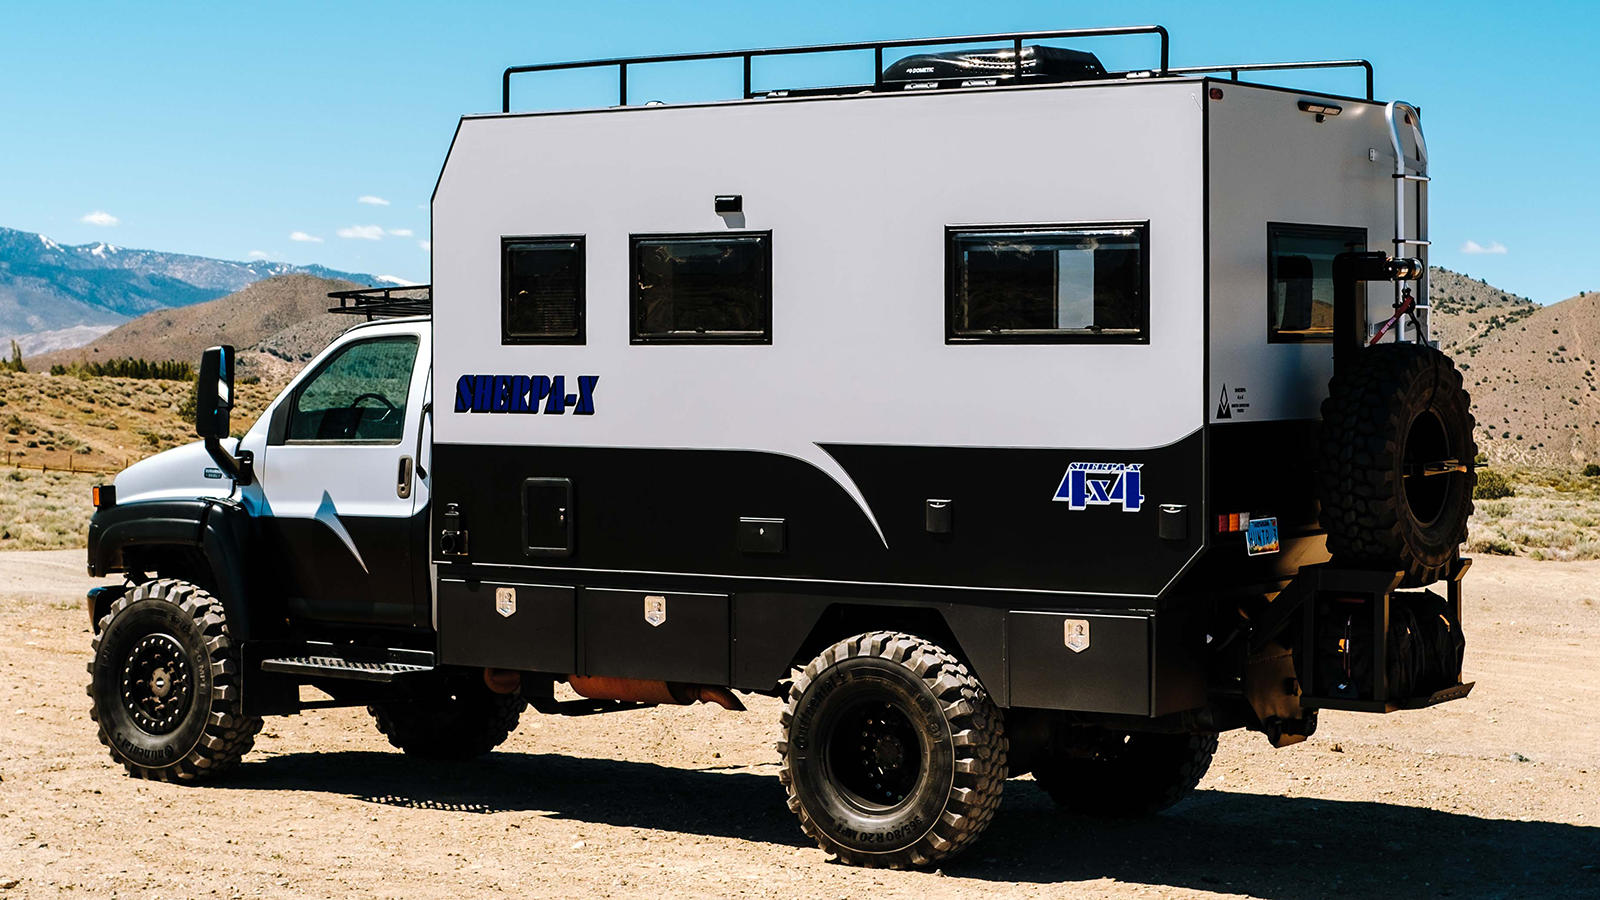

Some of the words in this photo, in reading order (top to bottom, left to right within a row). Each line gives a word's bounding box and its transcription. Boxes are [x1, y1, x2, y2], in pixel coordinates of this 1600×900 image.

[454, 374, 600, 415] SHERPA-X
[1069, 462, 1144, 471] SHERPA-X
[1052, 469, 1145, 512] 4x4
[793, 676, 836, 750] Continental
[121, 739, 174, 760] Continental
[886, 815, 924, 841] 365/80
